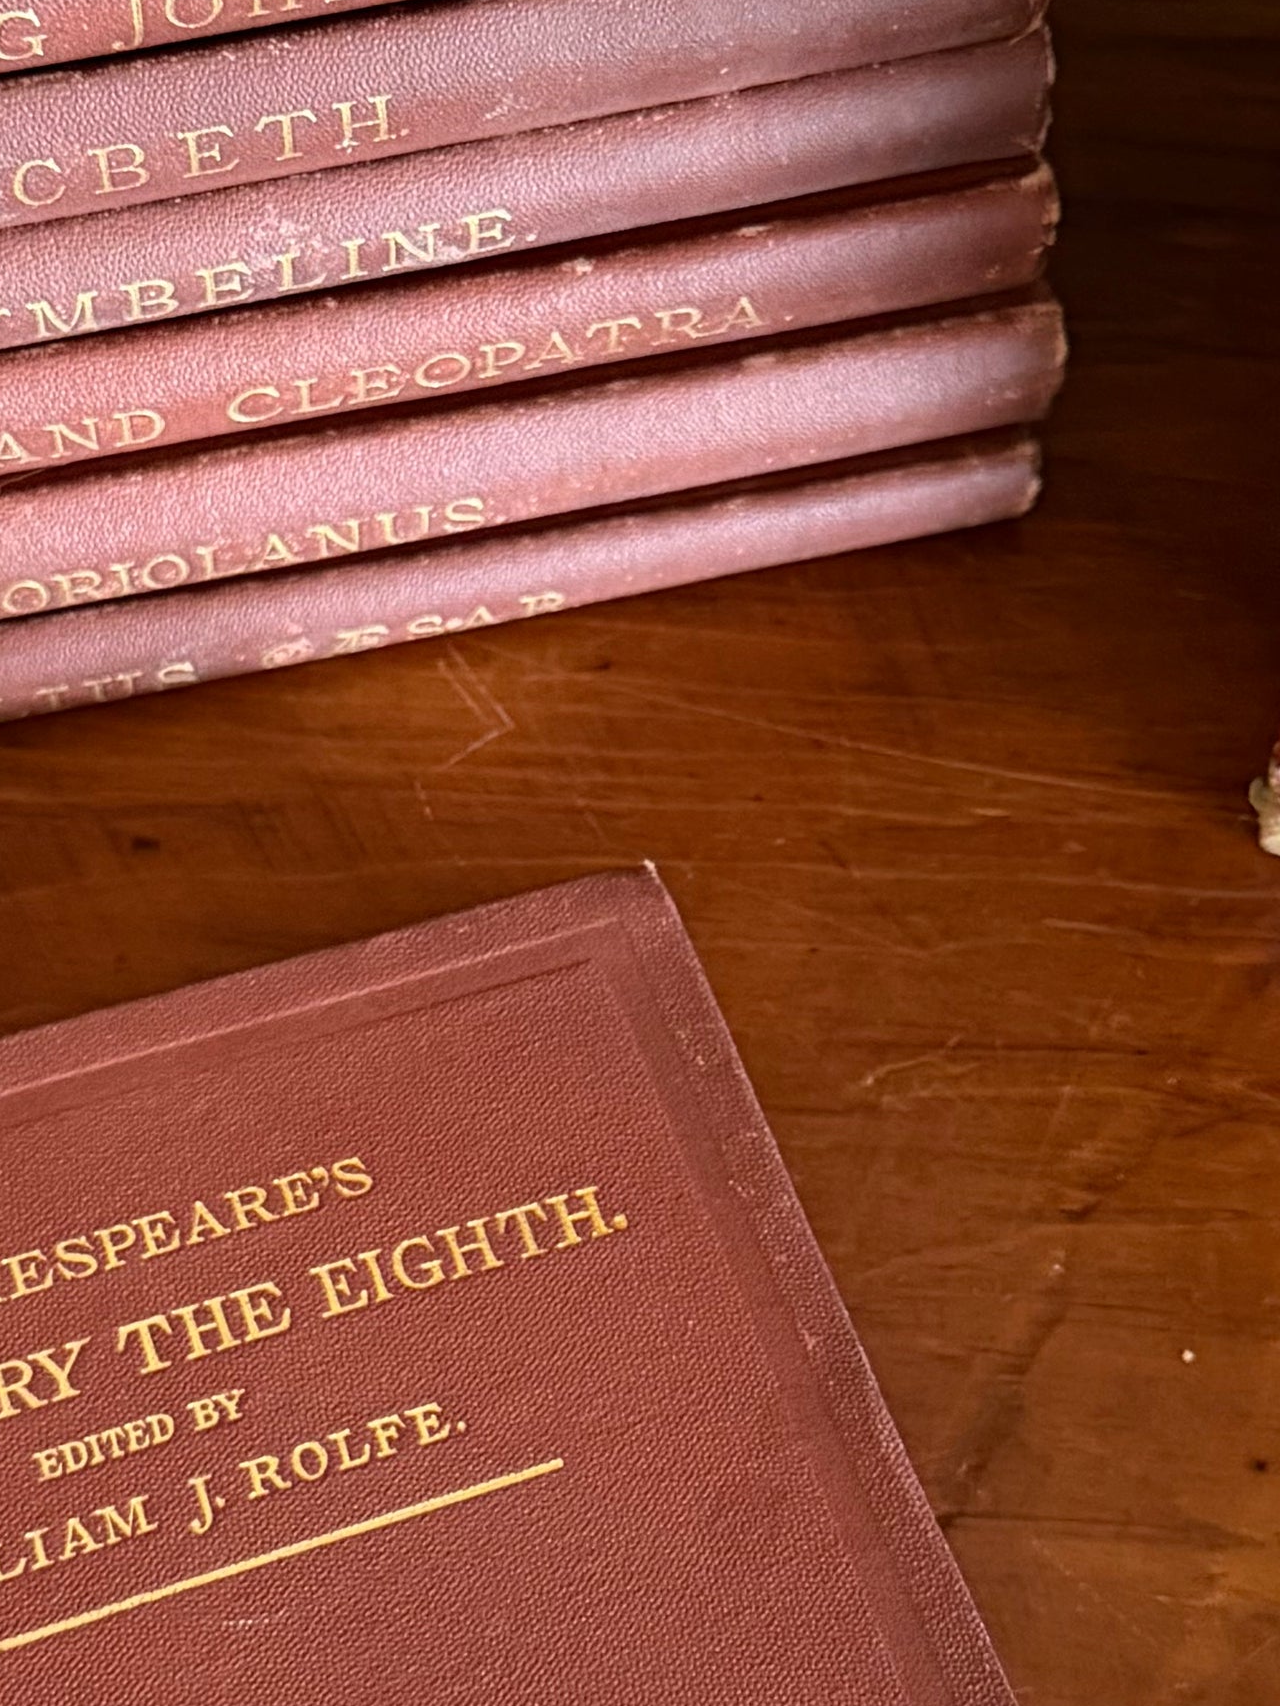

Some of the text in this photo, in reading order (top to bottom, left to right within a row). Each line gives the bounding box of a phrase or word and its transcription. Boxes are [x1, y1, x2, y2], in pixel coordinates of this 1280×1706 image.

[227, 296, 794, 424] CLEOPATRA.
[118, 1279, 293, 1378] THE
[311, 1184, 630, 1321] EIGHTH.
[34, 1389, 246, 1480] EDITED BY
[186, 1474, 227, 1533] J.
[245, 1400, 466, 1503] ROLFE.
